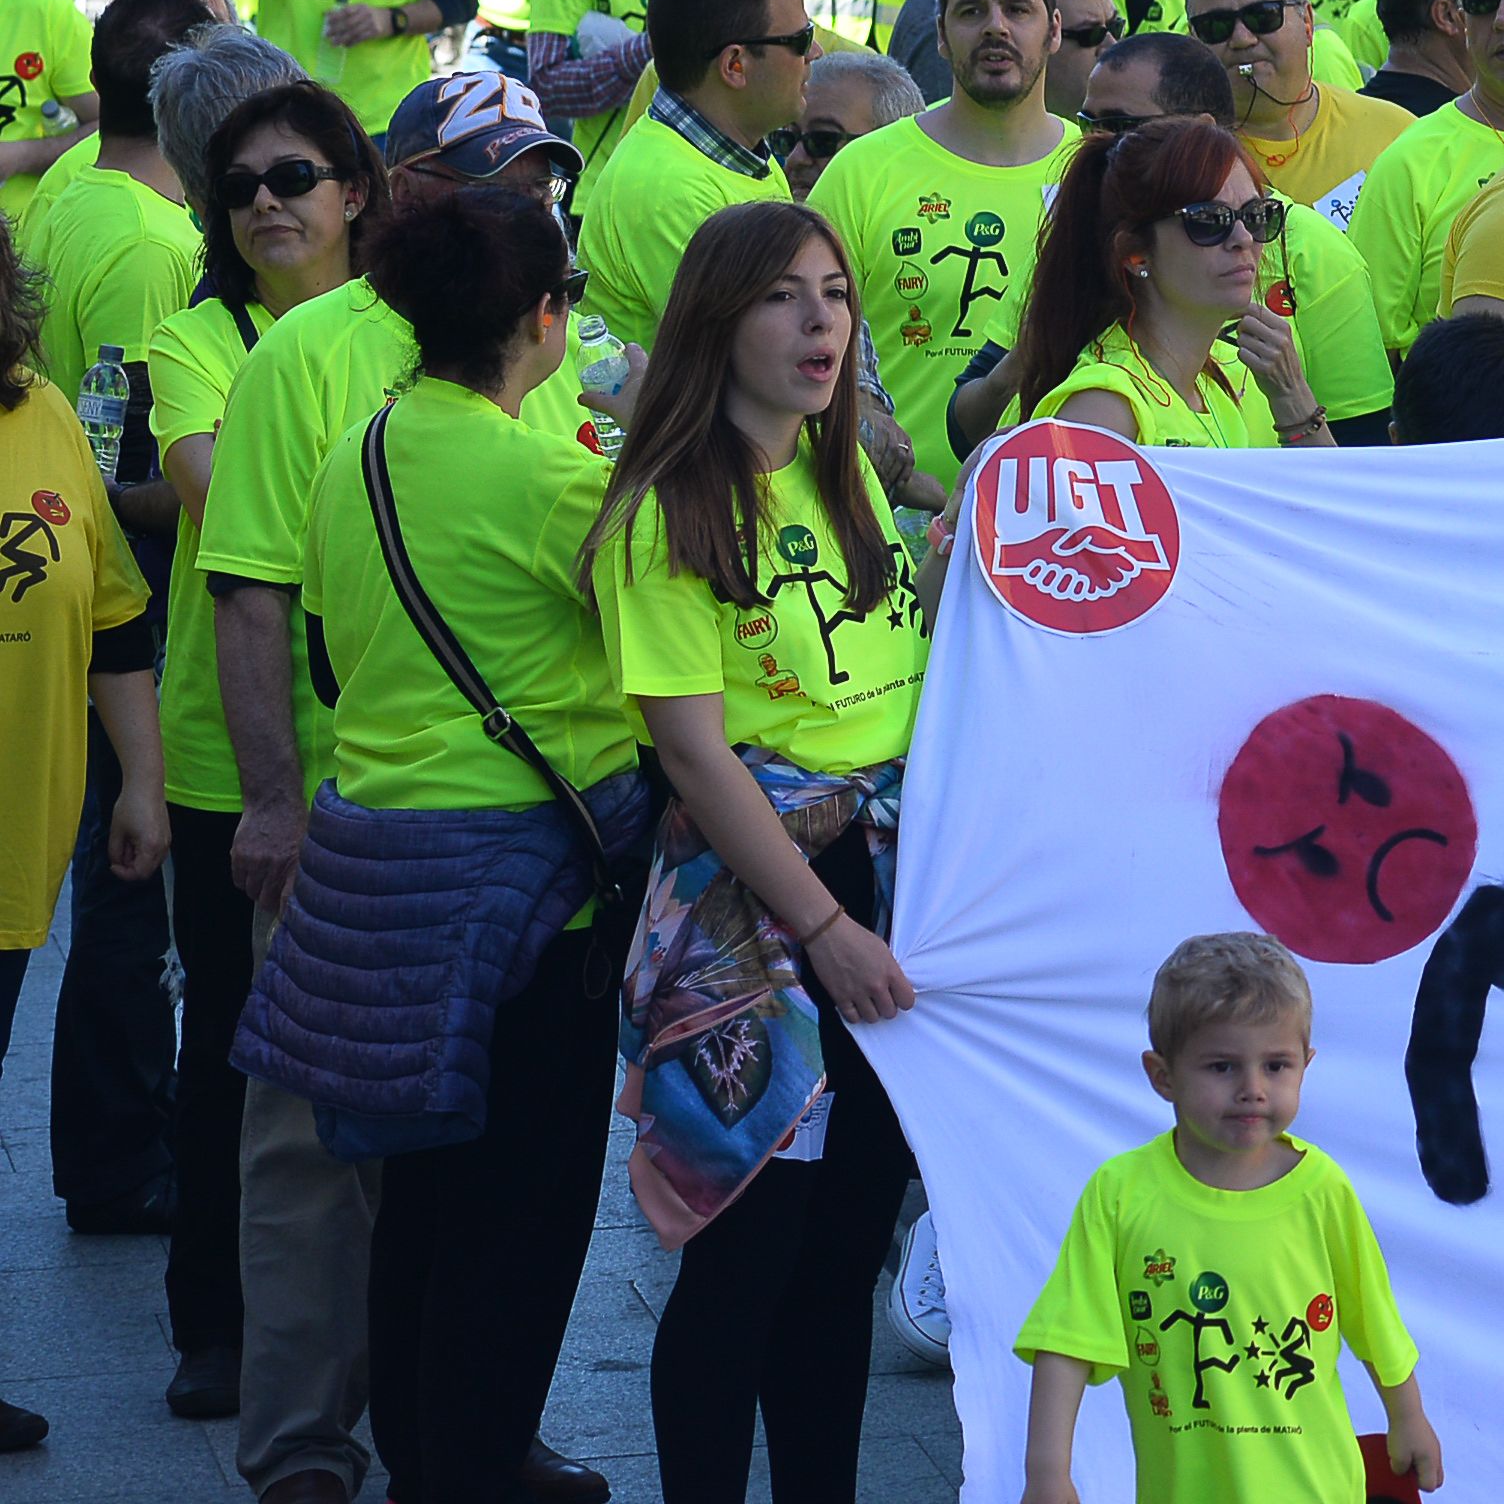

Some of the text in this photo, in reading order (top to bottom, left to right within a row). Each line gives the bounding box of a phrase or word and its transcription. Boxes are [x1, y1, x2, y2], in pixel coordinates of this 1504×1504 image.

[919, 202, 949, 215] ARIEL
[973, 222, 1001, 237] P&G
[897, 275, 925, 291] FAIRY
[998, 455, 1160, 553] UGT
[786, 533, 815, 557] P&G
[737, 615, 772, 641] FAIRY
[834, 691, 867, 712] FUTURO
[1145, 1261, 1174, 1276] ARIEL
[1197, 1285, 1225, 1301] P&G
[1260, 1425, 1272, 1434] de
